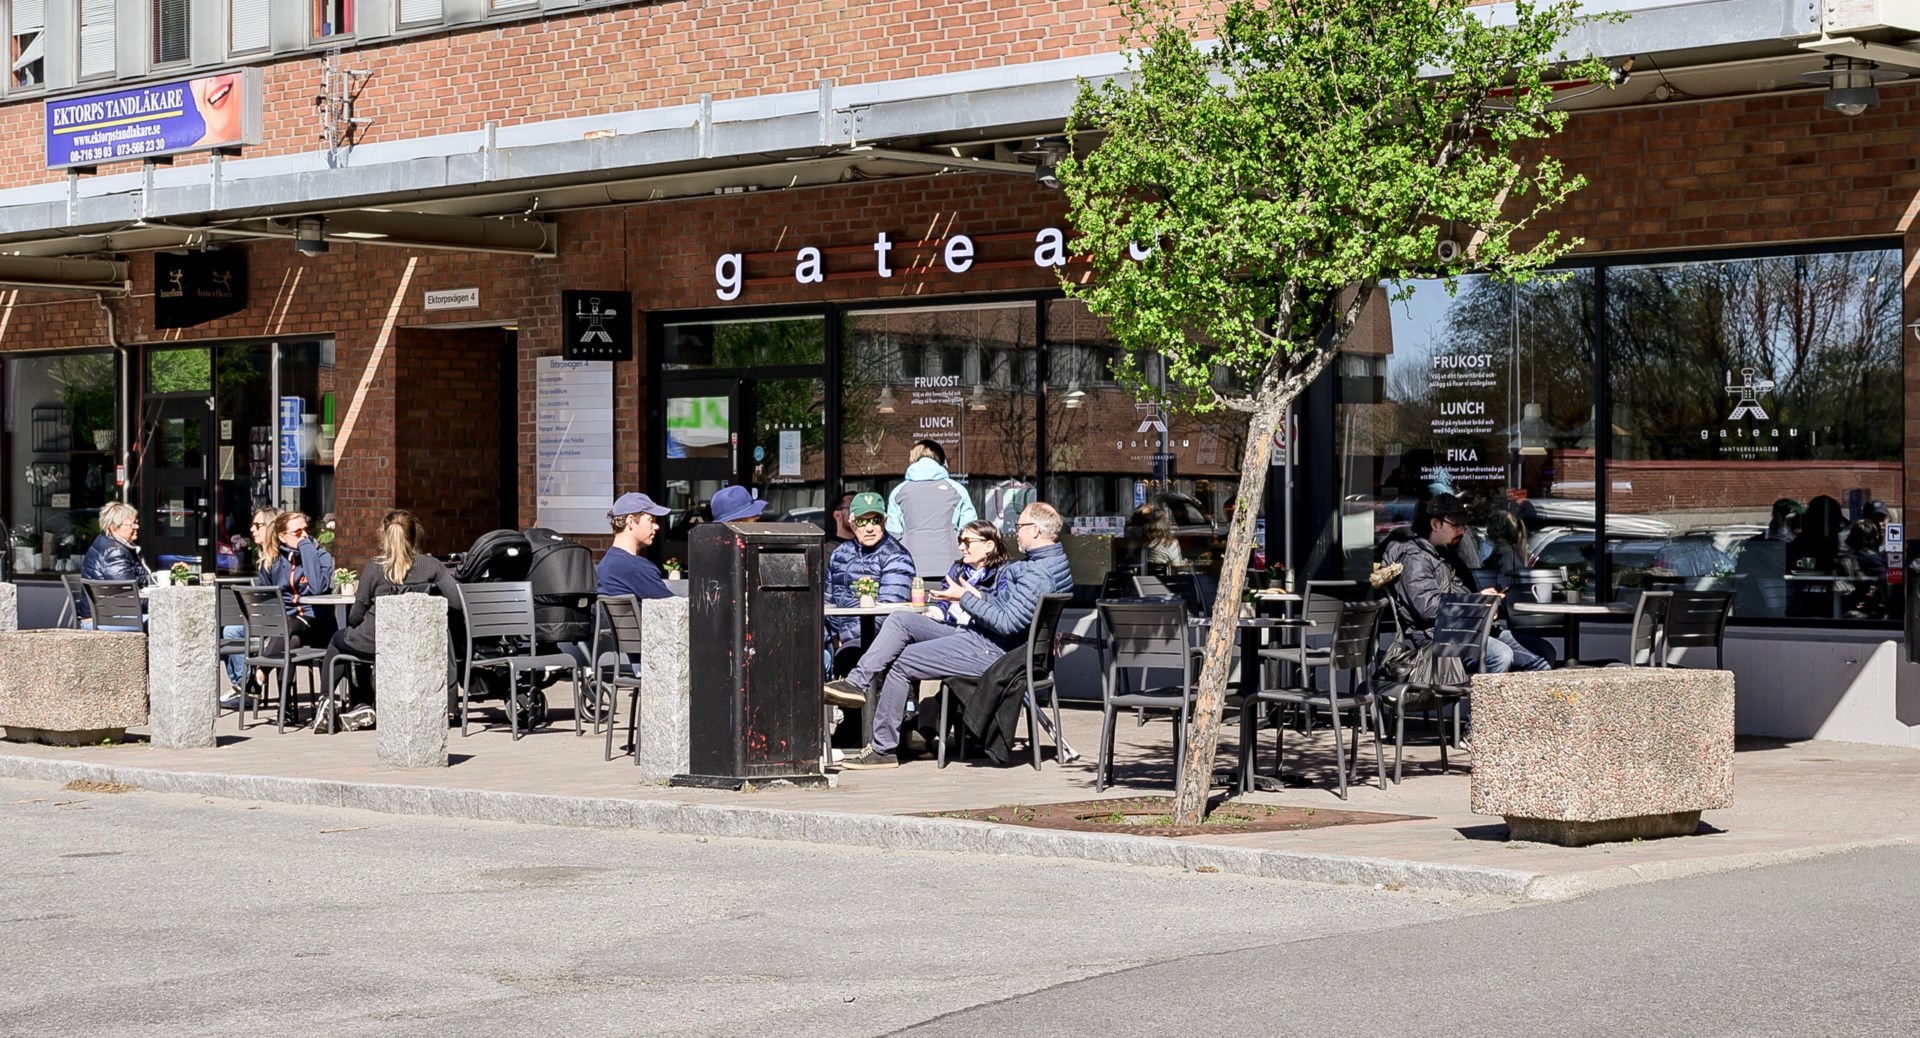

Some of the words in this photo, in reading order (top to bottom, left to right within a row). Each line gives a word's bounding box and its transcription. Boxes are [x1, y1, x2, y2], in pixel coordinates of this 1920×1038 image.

[53, 102, 104, 126] EKTORPS
[106, 90, 183, 118] TANDLÄKARE
[73, 124, 161, 146] www.ektorpstandlakare.se
[70, 149, 93, 162] 08-716
[94, 148, 102, 159] 39
[103, 146, 112, 158] 03
[146, 140, 155, 152] 23
[156, 138, 165, 150] 30
[428, 294, 468, 304] Ektorpsvägen
[471, 292, 475, 301] 4
[1433, 354, 1493, 368] FRUKOST
[914, 375, 959, 388] FRUKOST
[1441, 402, 1484, 415] LUNCH
[765, 422, 812, 430] gateau
[920, 416, 953, 428] LUNCH
[1700, 427, 1798, 440] gateau
[1117, 439, 1189, 449] gateau
[1447, 449, 1478, 461] FIKA
